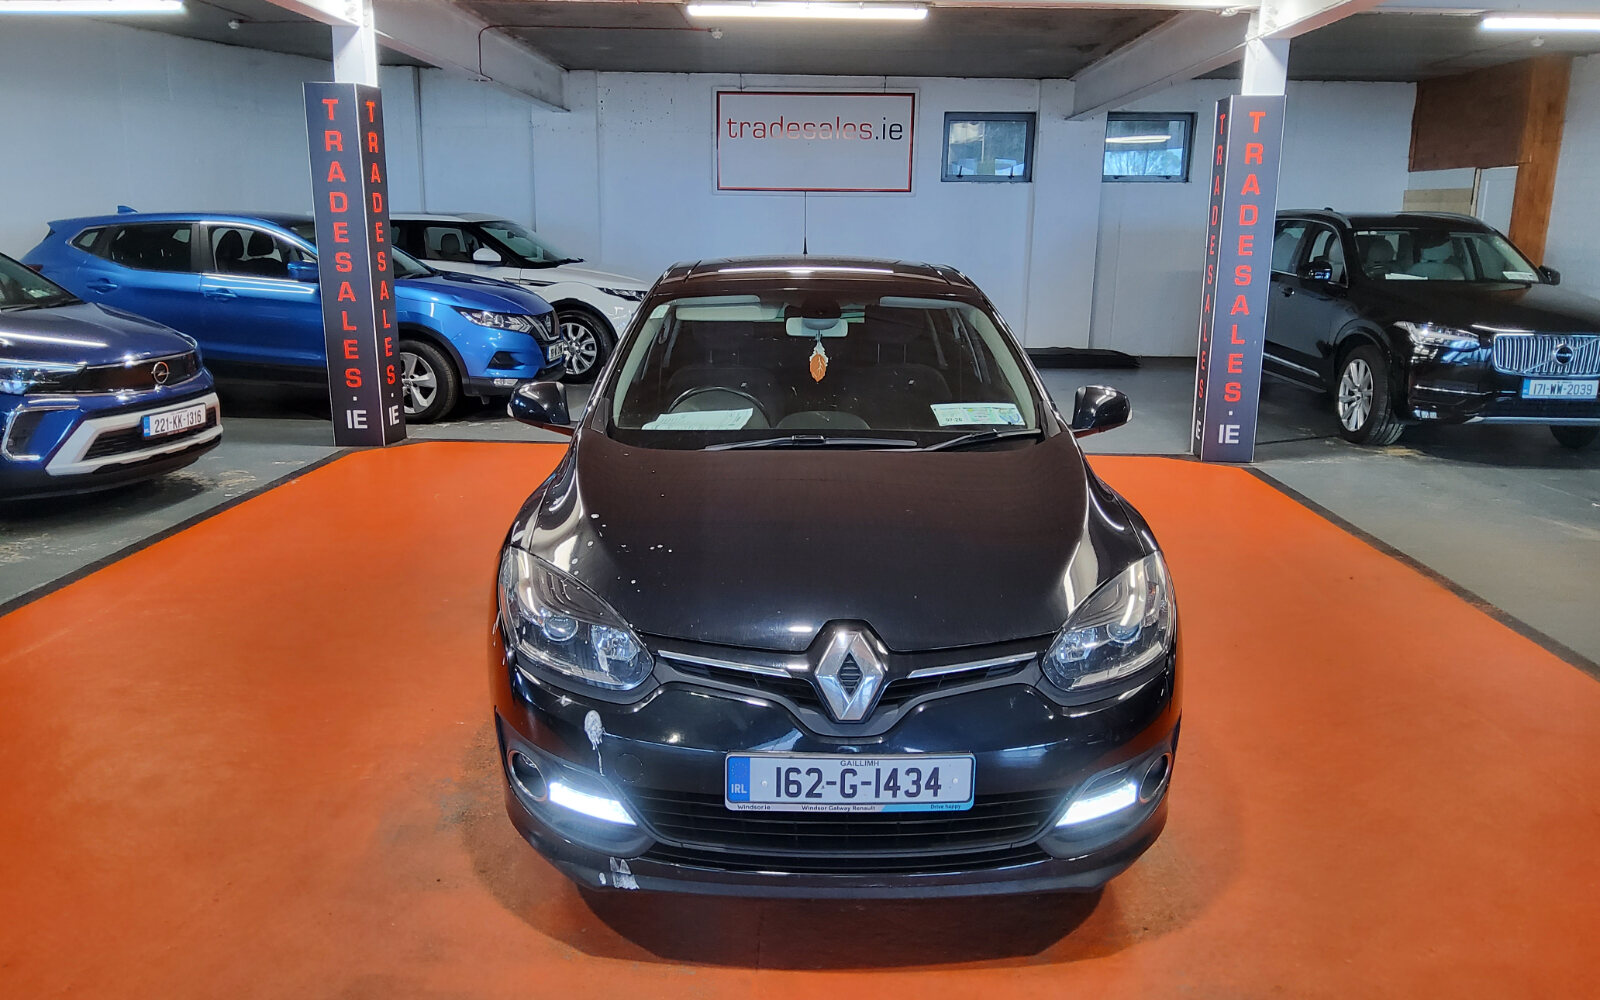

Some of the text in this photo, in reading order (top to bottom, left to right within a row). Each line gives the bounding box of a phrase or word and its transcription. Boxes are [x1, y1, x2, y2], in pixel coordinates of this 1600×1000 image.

[726, 115, 903, 141] tradesales.ie
[1533, 383, 1593, 396] 171-WW-2039
[154, 409, 202, 433] 221-KK-1316
[731, 783, 748, 794] IRL
[776, 767, 942, 799] 162-G-1434
